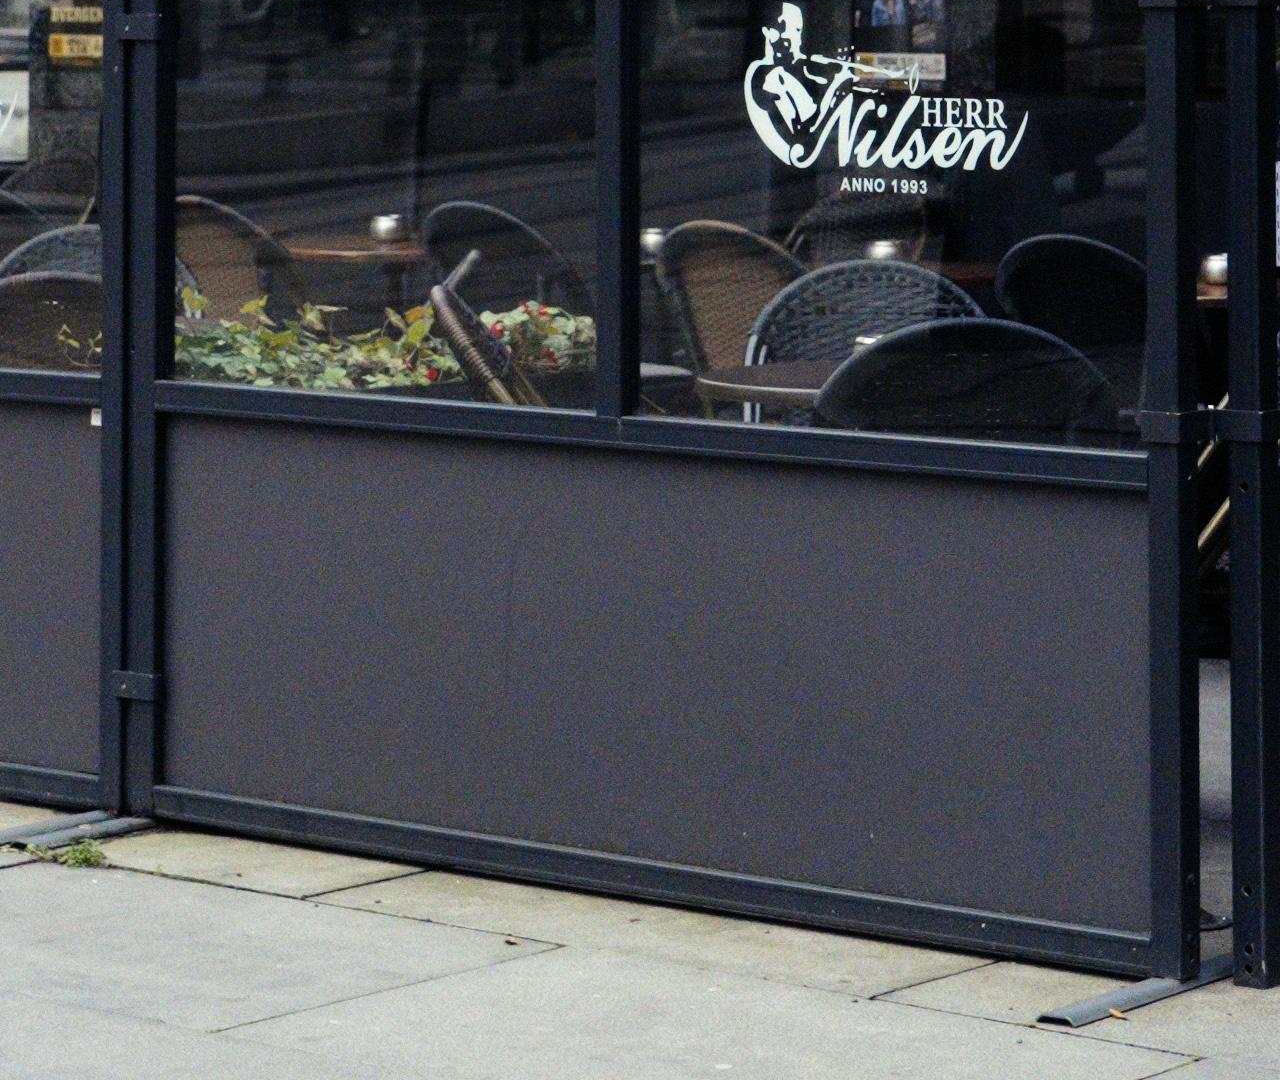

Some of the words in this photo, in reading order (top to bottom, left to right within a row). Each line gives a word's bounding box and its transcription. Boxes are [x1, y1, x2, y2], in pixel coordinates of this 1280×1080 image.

[921, 97, 1008, 129] HERR
[791, 90, 1029, 171] Nilsen
[840, 177, 886, 193] ANNO
[891, 180, 928, 195] 1993
